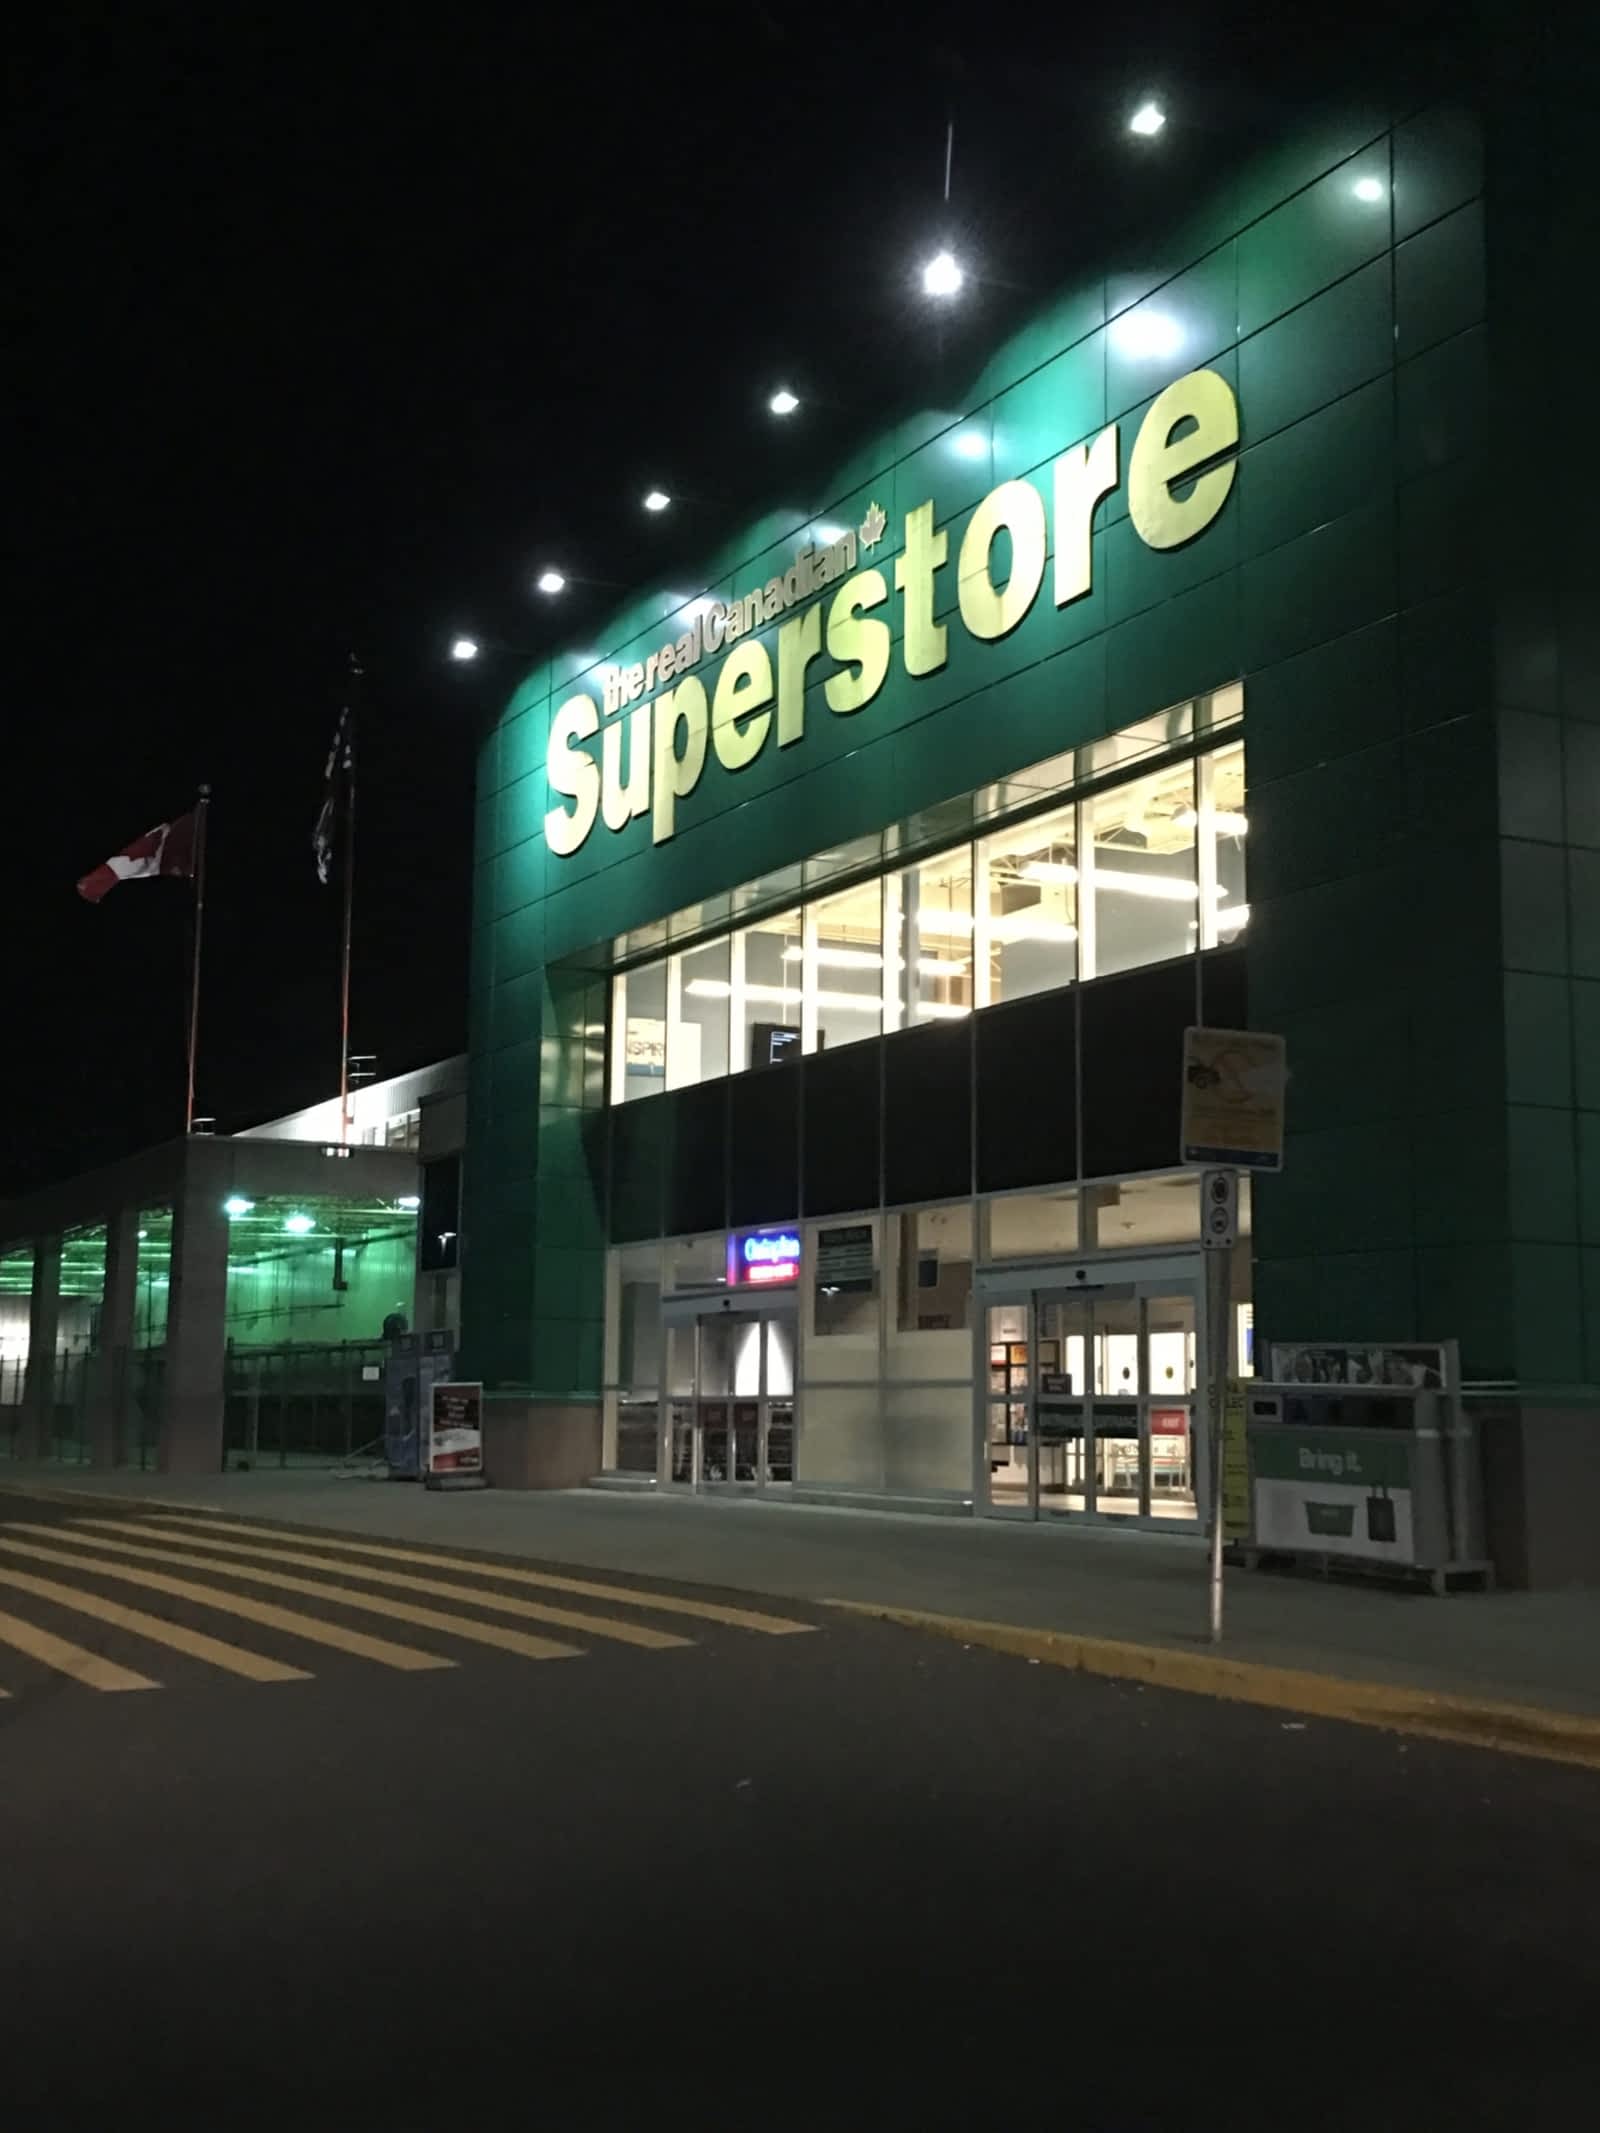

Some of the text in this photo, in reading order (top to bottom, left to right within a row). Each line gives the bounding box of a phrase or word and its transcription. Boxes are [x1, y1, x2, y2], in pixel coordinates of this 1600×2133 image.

[543, 368, 1241, 857] Superstore
[602, 528, 857, 717] the real Canadian
